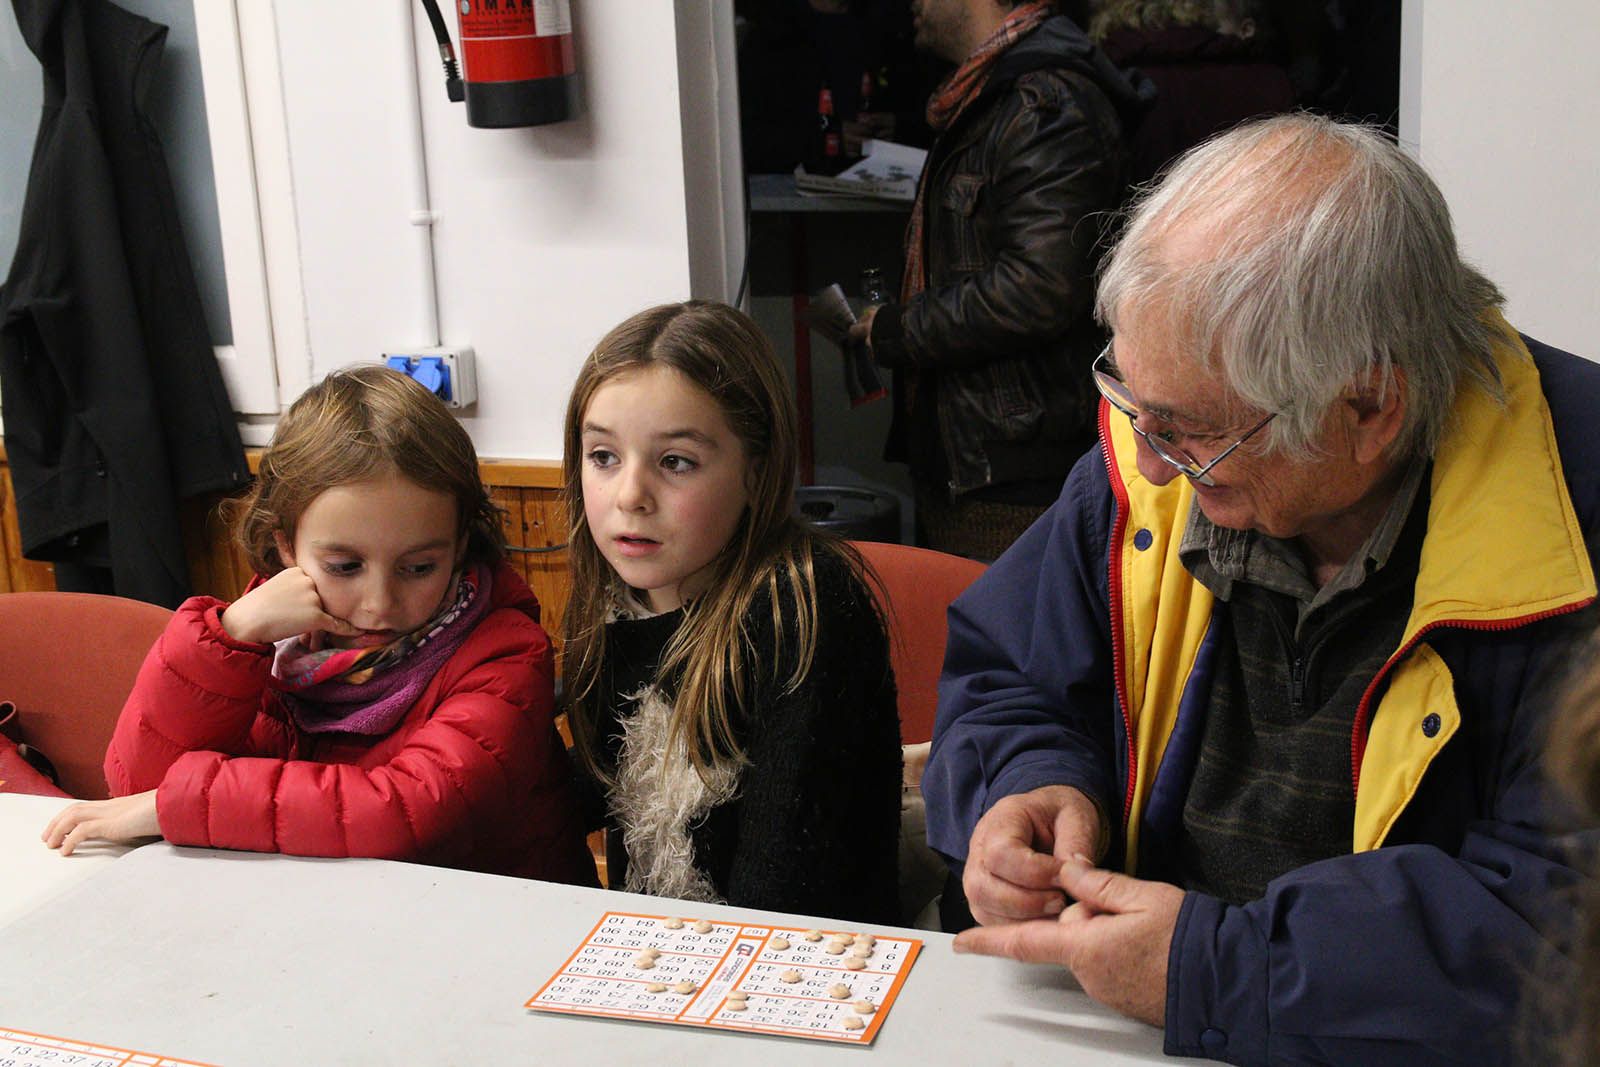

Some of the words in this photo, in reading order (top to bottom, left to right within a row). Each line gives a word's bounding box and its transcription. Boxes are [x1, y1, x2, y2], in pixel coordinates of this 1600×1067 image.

[608, 917, 625, 925] 10
[636, 920, 656, 928] 84
[601, 927, 621, 935] 90
[716, 927, 736, 935] 54
[655, 932, 674, 940] 79
[709, 937, 729, 945] 59
[797, 945, 818, 953] 39
[886, 953, 896, 961] 9
[604, 960, 625, 968] 89
[694, 959, 714, 967] 52
[625, 972, 644, 980] 75
[815, 970, 833, 978] 21
[587, 980, 609, 988] 87
[806, 980, 828, 988] 29
[608, 991, 627, 999] 73
[773, 987, 793, 995] 35
[765, 997, 785, 1005] 34
[757, 1007, 779, 1015] 33
[787, 1010, 809, 1018] 26
[750, 1017, 773, 1025] 32
[781, 1019, 802, 1027] 25
[810, 1021, 828, 1029] 18
[11, 1046, 32, 1056] 13
[33, 1051, 59, 1060] 22
[62, 1055, 87, 1064] 37
